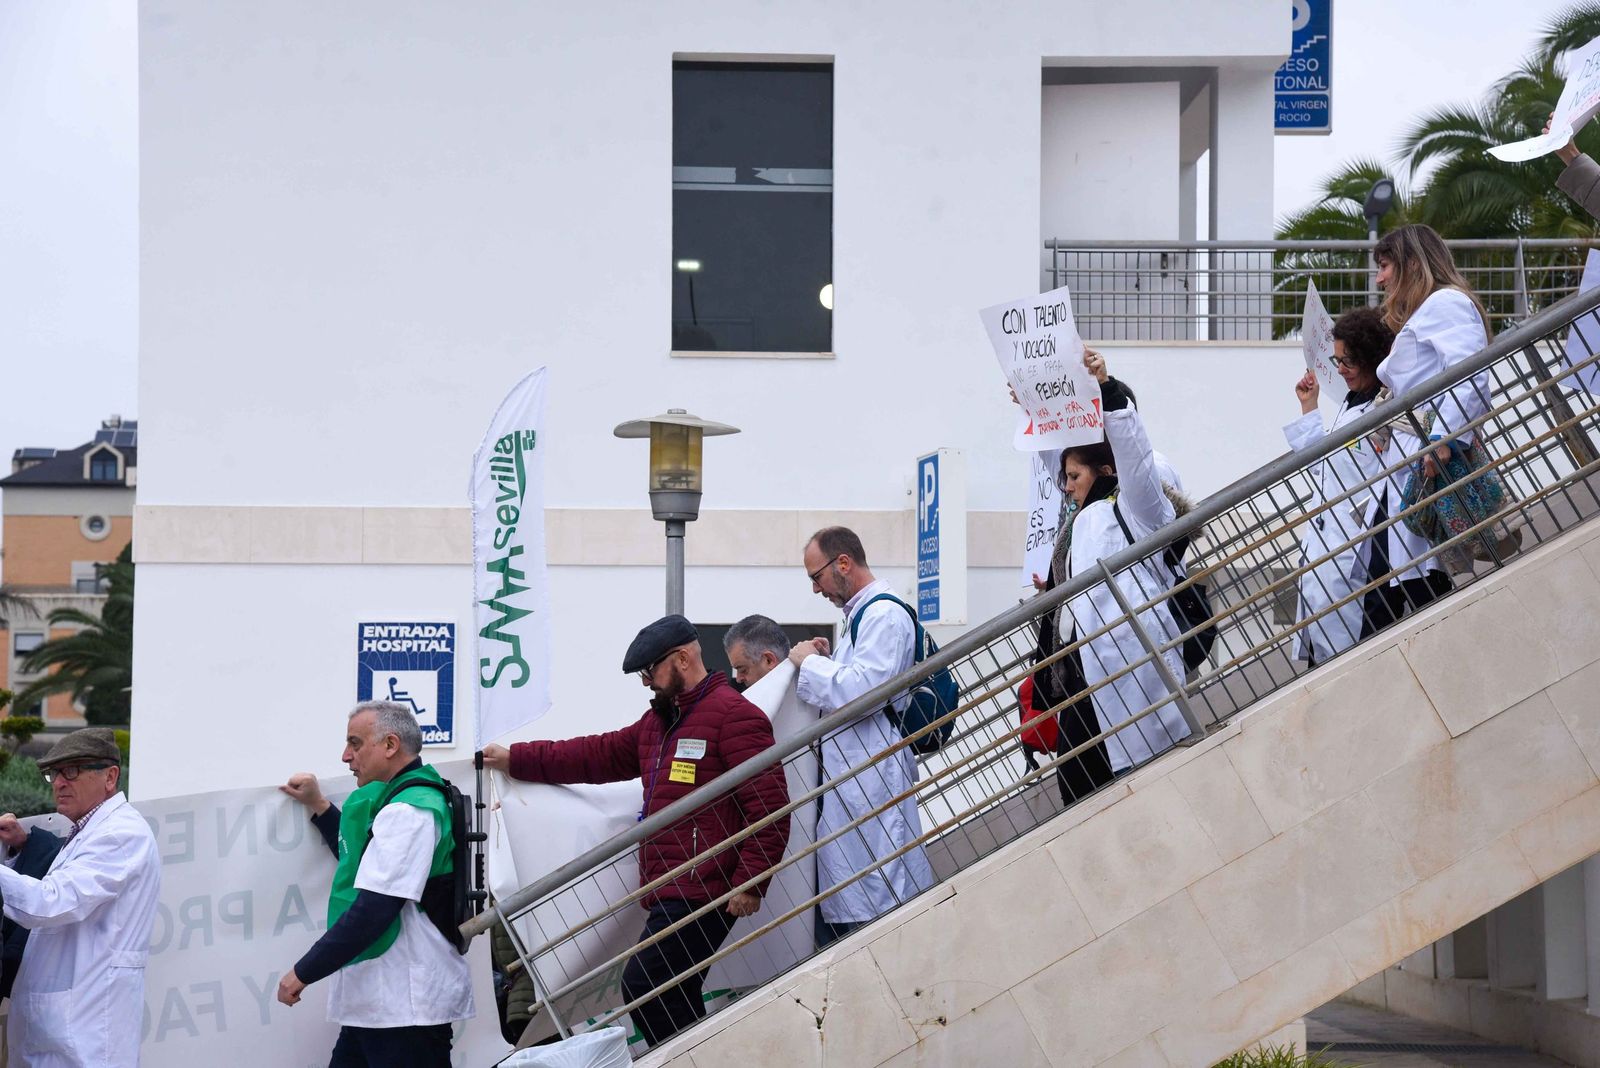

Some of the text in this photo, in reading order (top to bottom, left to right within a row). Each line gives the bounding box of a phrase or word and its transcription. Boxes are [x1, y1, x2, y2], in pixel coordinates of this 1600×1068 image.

[1291, 101, 1327, 110] VIRGEN
[1002, 302, 1067, 335] CON TALENTO
[1013, 334, 1056, 361] Y VOCACIÓN
[1035, 374, 1076, 401] PENSIÓN
[924, 461, 936, 532] P
[1037, 477, 1052, 504] NO
[1030, 507, 1044, 528] ES
[921, 535, 939, 555] ACCESO
[363, 625, 451, 638] ENTRADA
[363, 639, 451, 652] HOSPITAL
